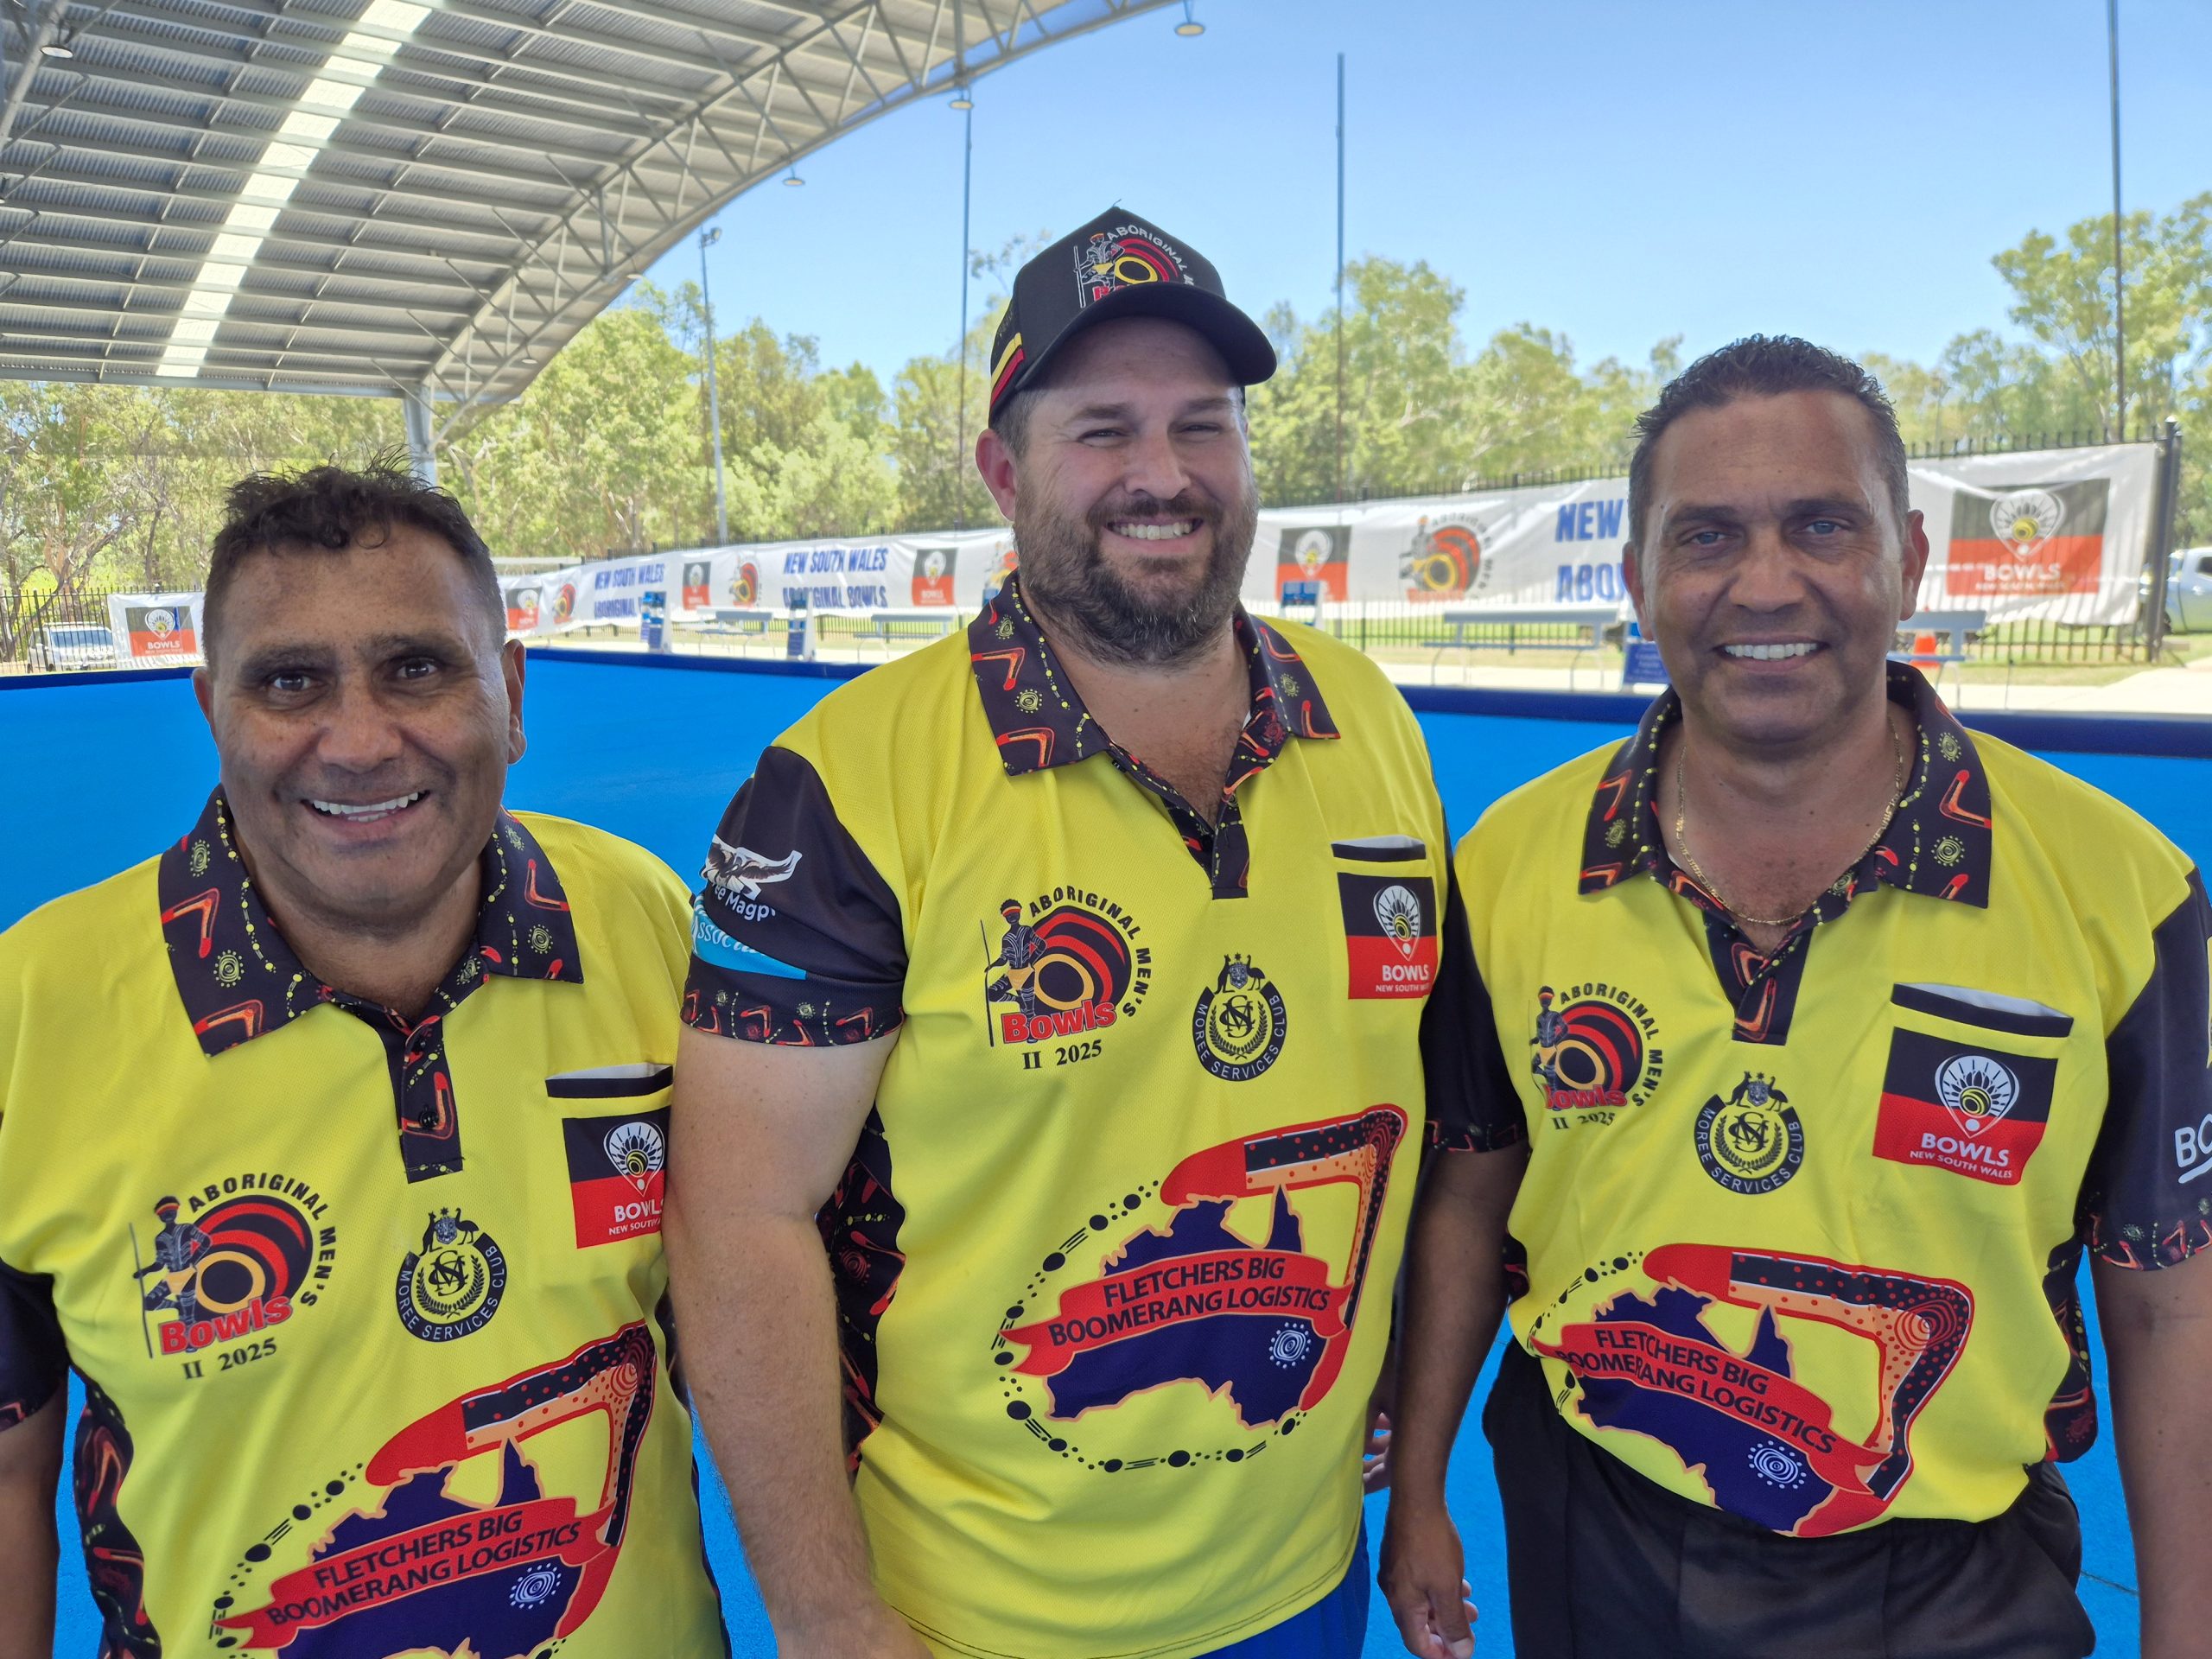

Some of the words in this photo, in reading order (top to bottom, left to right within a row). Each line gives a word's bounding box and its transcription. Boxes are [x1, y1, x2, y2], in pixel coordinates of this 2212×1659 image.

[1107, 225, 1187, 271] ABORIGINAL
[1555, 499, 1624, 542] NEW
[594, 571, 612, 590] NEW
[612, 567, 638, 587] SOUTH
[638, 563, 665, 584] WALES
[784, 551, 810, 574] NEW
[810, 550, 846, 574] SOUTH
[849, 547, 889, 572] WALES
[1984, 563, 2062, 582] BOWLS
[847, 585, 888, 607] BOWLS
[147, 640, 181, 650] BOWLS
[1029, 886, 1141, 940] ABORIGINAL
[1122, 947, 1152, 1018] MEN'S
[1376, 984, 1393, 993] NEW
[1395, 983, 1420, 992] SOUTH
[1001, 999, 1117, 1044] Bowls
[1195, 1003, 1210, 1063] MOREE
[1211, 1044, 1279, 1079] SERVICES
[1269, 995, 1286, 1037] CLUB
[1022, 1051, 1042, 1070] II
[1055, 1039, 1103, 1065] 2025
[1560, 982, 1659, 1040] ABORIGINAL
[1631, 1049, 1663, 1107] MEN'S
[1577, 1111, 1616, 1126] 2025
[1696, 1107, 1716, 1162] MOREE
[1711, 1167, 1791, 1193] SERVICES
[1788, 1121, 1803, 1164] CLUB
[1910, 1150, 1936, 1160] NEW
[1937, 1154, 1977, 1173] SOUTH
[1980, 1166, 2012, 1179] WALES
[1921, 1132, 2010, 1167] BOWLS
[188, 1173, 329, 1221] ABORIGINAL
[300, 1226, 336, 1307] MEN'S
[608, 1224, 628, 1236] NEW
[398, 1270, 420, 1330] MOREE
[422, 1297, 499, 1340] SERVICES
[485, 1245, 505, 1288] CLUB
[1103, 1258, 1243, 1308] FLETCHERS
[1248, 1256, 1286, 1280] BIG
[157, 1295, 293, 1355] Bowls
[1047, 1293, 1223, 1347] BOOMERANG
[1226, 1285, 1332, 1313] LOGISTICS
[181, 1359, 204, 1380] II
[218, 1337, 277, 1371] 2025
[1595, 1329, 1719, 1375] FLETCHERS
[1722, 1362, 1770, 1395] BIG
[1700, 1380, 1837, 1454] LOGISTICS
[314, 1524, 474, 1589] FLETCHERS
[478, 1510, 523, 1543] BIG
[266, 1560, 452, 1626] BOOMERANG
[456, 1521, 582, 1577] LOGISTICS
